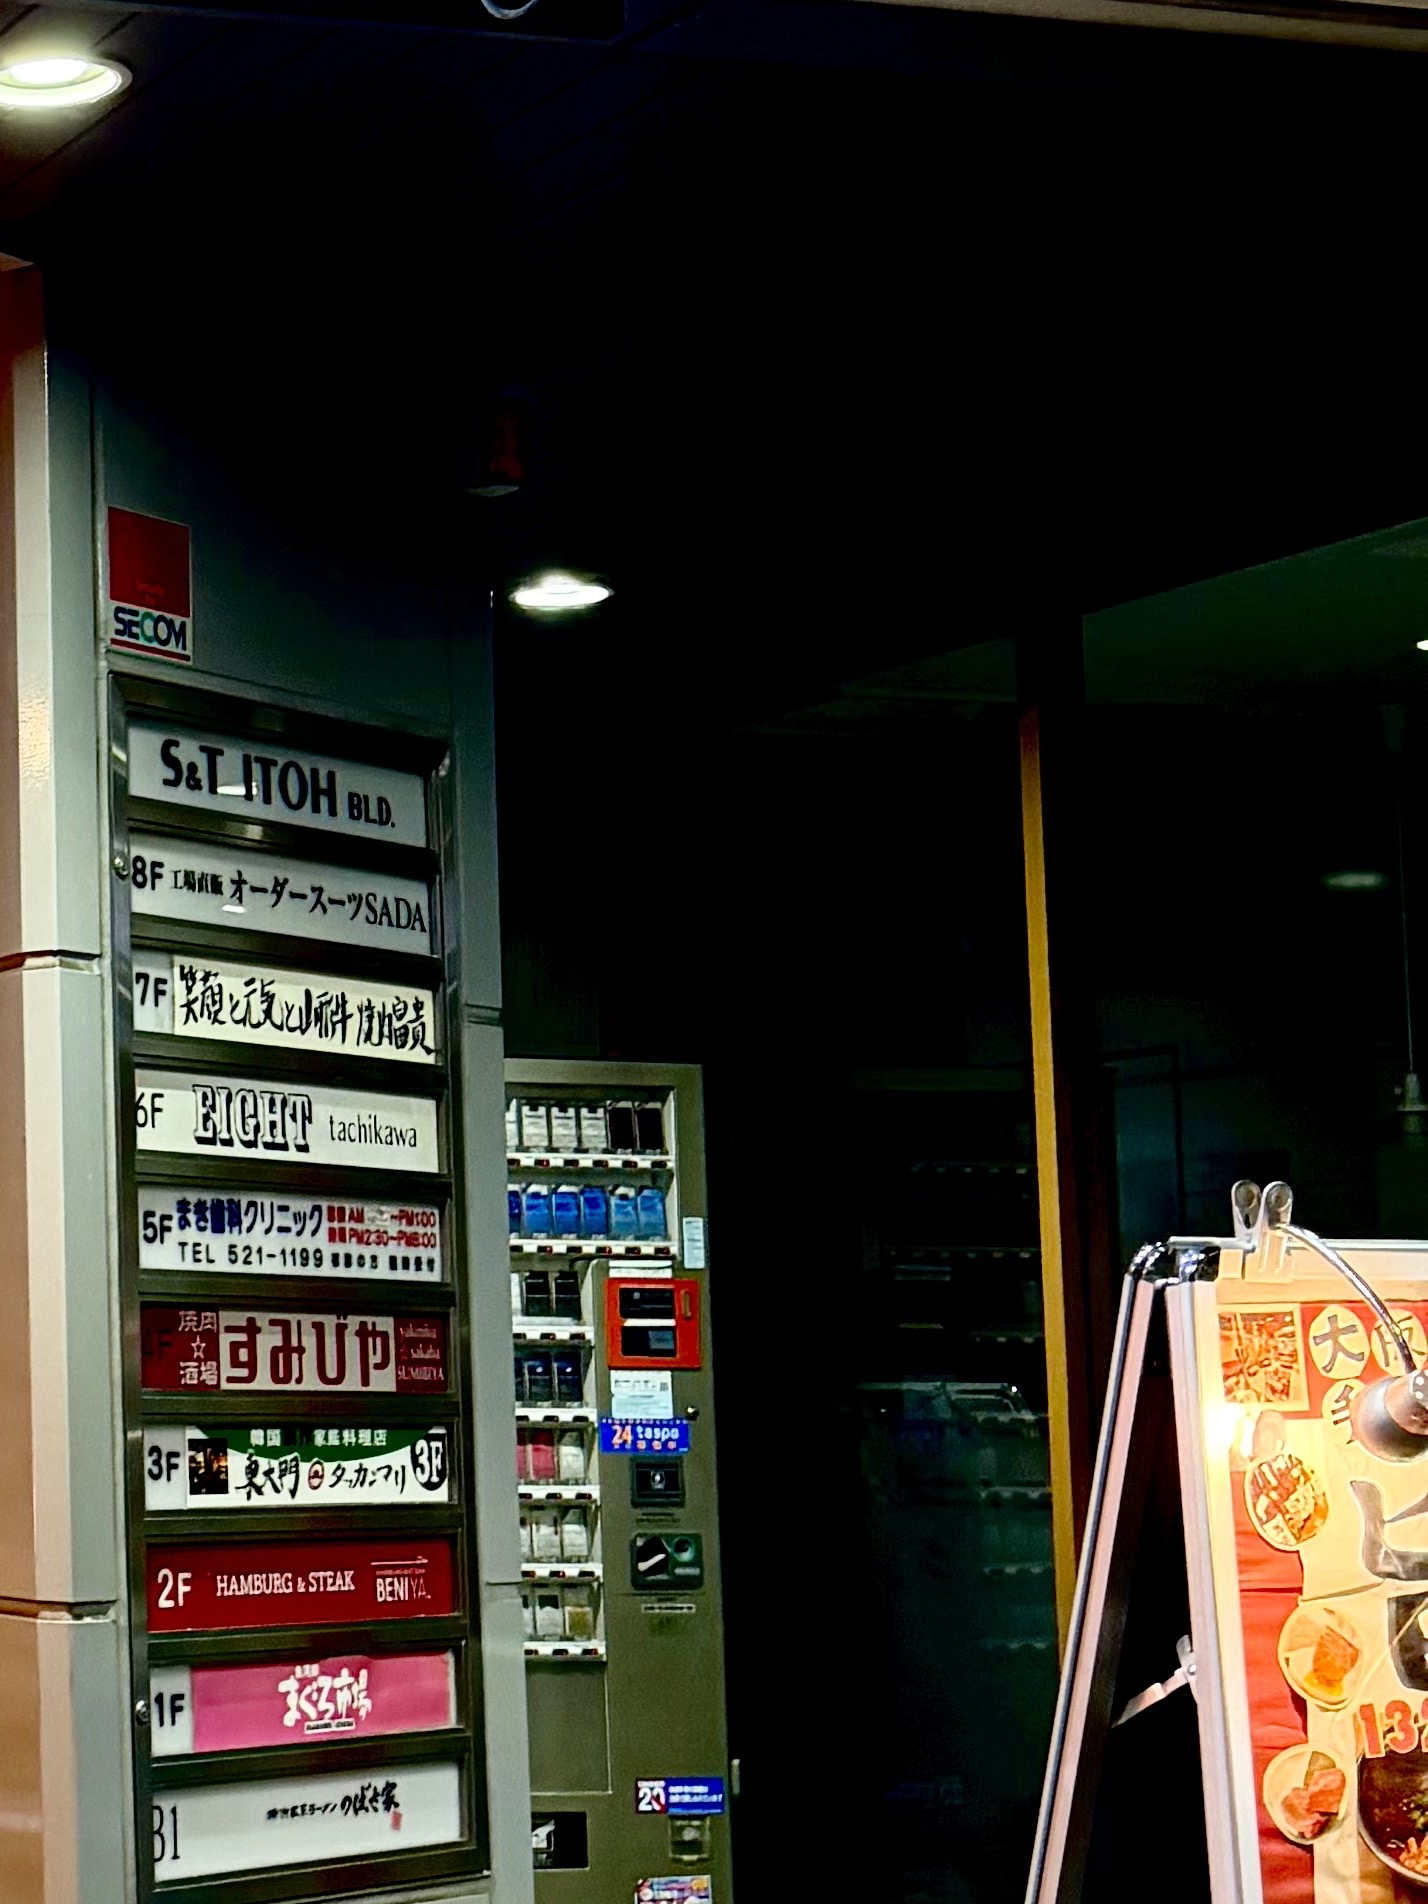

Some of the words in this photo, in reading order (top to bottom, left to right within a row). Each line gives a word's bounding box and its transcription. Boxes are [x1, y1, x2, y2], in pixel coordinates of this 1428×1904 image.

[113, 607, 187, 651] SECOM
[161, 739, 225, 792] S&T
[242, 754, 338, 817] ITOH
[348, 791, 396, 828] BLD.
[132, 855, 164, 891] 8F
[135, 973, 168, 1007] 7F
[135, 1092, 164, 1128] 6F
[192, 1084, 313, 1153] EIGHT
[329, 1114, 417, 1148] tachikawa
[143, 1211, 173, 1244] 5F
[178, 1242, 215, 1264] TEL
[224, 1315, 390, 1387] すみびや
[147, 1445, 180, 1482] 3F
[414, 1439, 444, 1484] 3F
[157, 1569, 192, 1608] 2F
[216, 1572, 293, 1597] HAMBURG
[309, 1571, 355, 1592] STEAK
[154, 1692, 185, 1727] 1F
